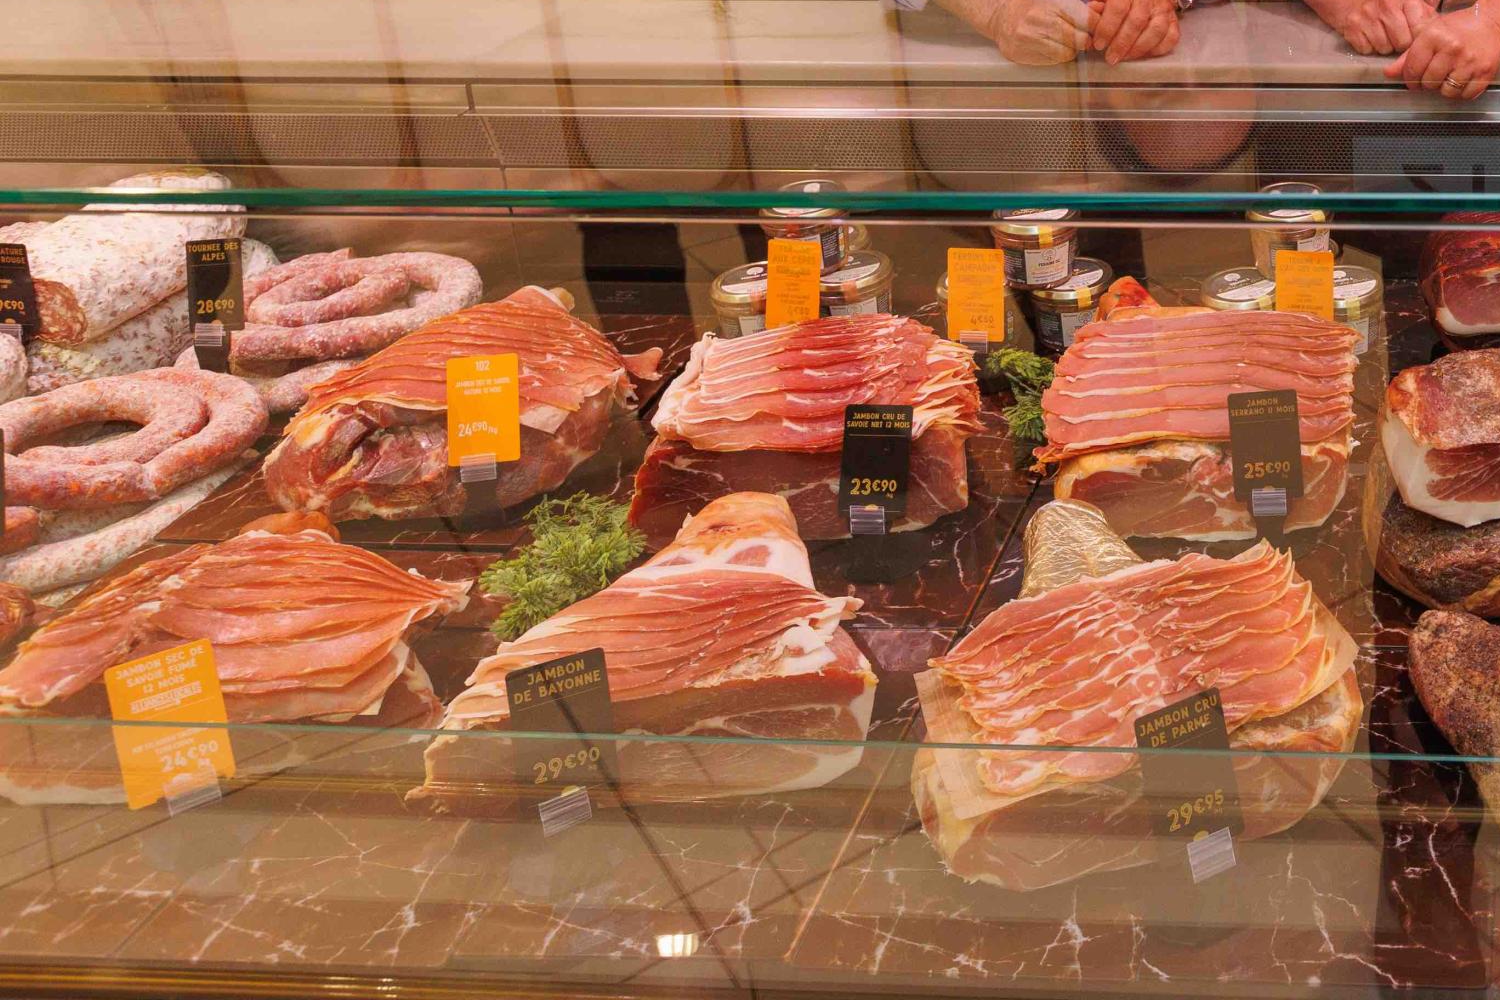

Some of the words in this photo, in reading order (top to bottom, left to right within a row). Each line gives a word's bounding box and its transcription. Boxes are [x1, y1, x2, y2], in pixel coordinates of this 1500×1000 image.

[0, 248, 24, 256] ATURE
[201, 252, 225, 262] ALPES
[196, 299, 235, 314] 28€90
[476, 360, 490, 372] 102
[1231, 407, 1265, 417] SERRANO
[1276, 405, 1295, 413] MOIS
[1247, 397, 1278, 408] JAMBON
[846, 420, 869, 428] SAVOIE
[852, 412, 880, 420] JAMBON
[1243, 460, 1291, 479] 25€90
[850, 478, 897, 496] 23€90
[115, 659, 161, 680] JAMBON
[165, 651, 185, 665] SEC
[190, 646, 204, 657] DE
[126, 670, 164, 688] SAVOIE
[527, 659, 585, 686] JAMBON
[143, 683, 154, 693] 12
[158, 674, 185, 688] MOIS
[514, 689, 532, 705] DE
[539, 669, 601, 698] BAYONNE
[1139, 707, 1190, 737] JAMBON
[1194, 694, 1218, 713] CRU
[1151, 732, 1168, 748] DE
[1172, 713, 1212, 739] PARME
[161, 740, 218, 773] 24€90
[533, 746, 600, 785] 29€90
[1167, 788, 1225, 833] 29€95
